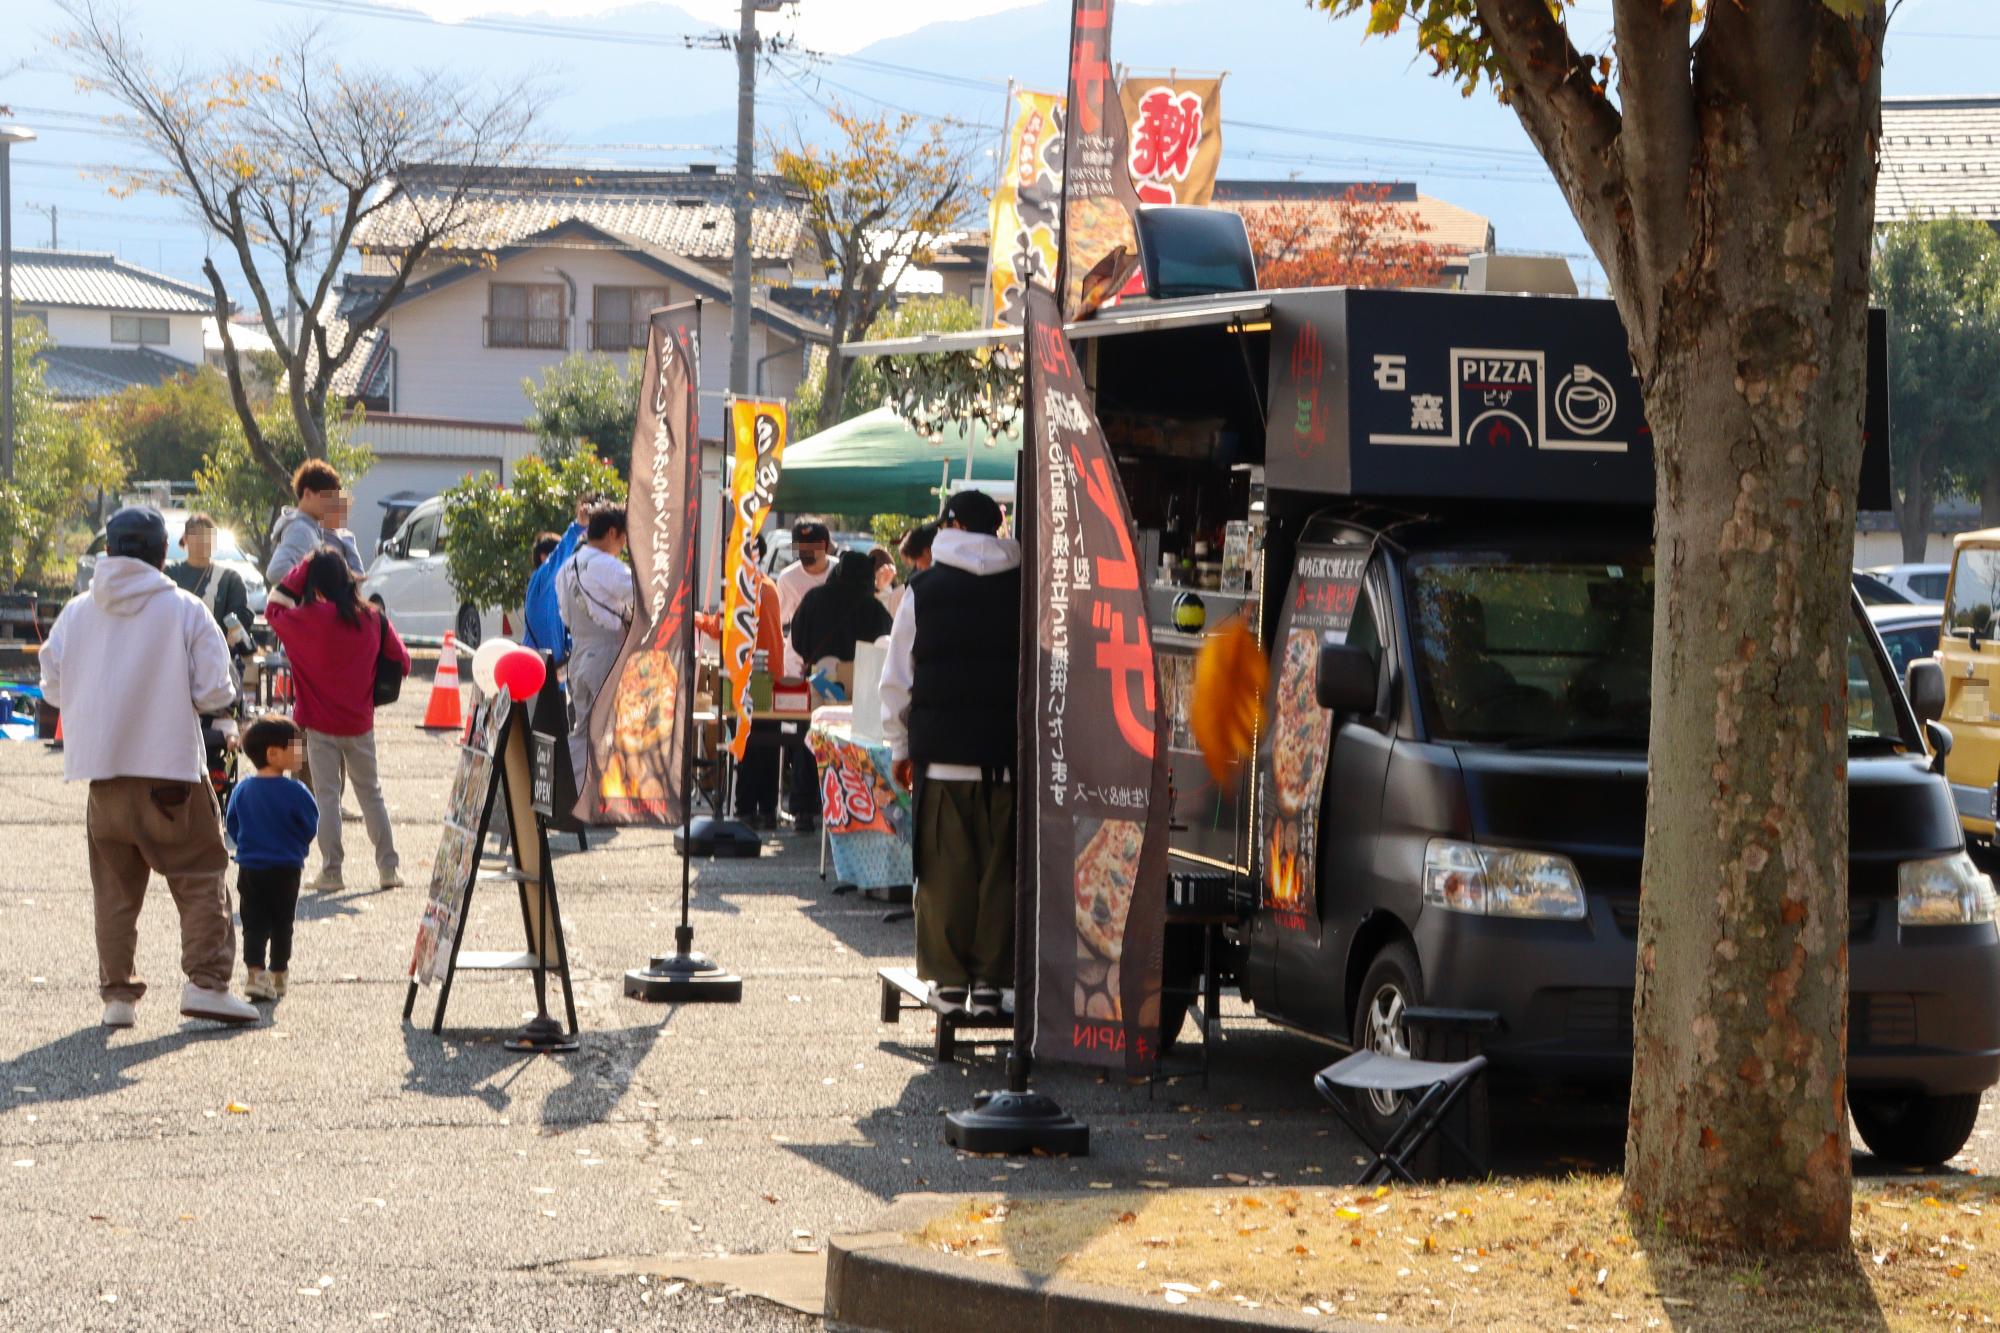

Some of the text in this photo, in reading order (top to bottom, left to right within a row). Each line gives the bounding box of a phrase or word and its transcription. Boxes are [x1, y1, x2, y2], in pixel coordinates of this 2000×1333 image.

[1463, 360, 1533, 384] PIZZA
[1483, 389, 1513, 407] ピザ
[535, 779, 551, 803] OPEN
